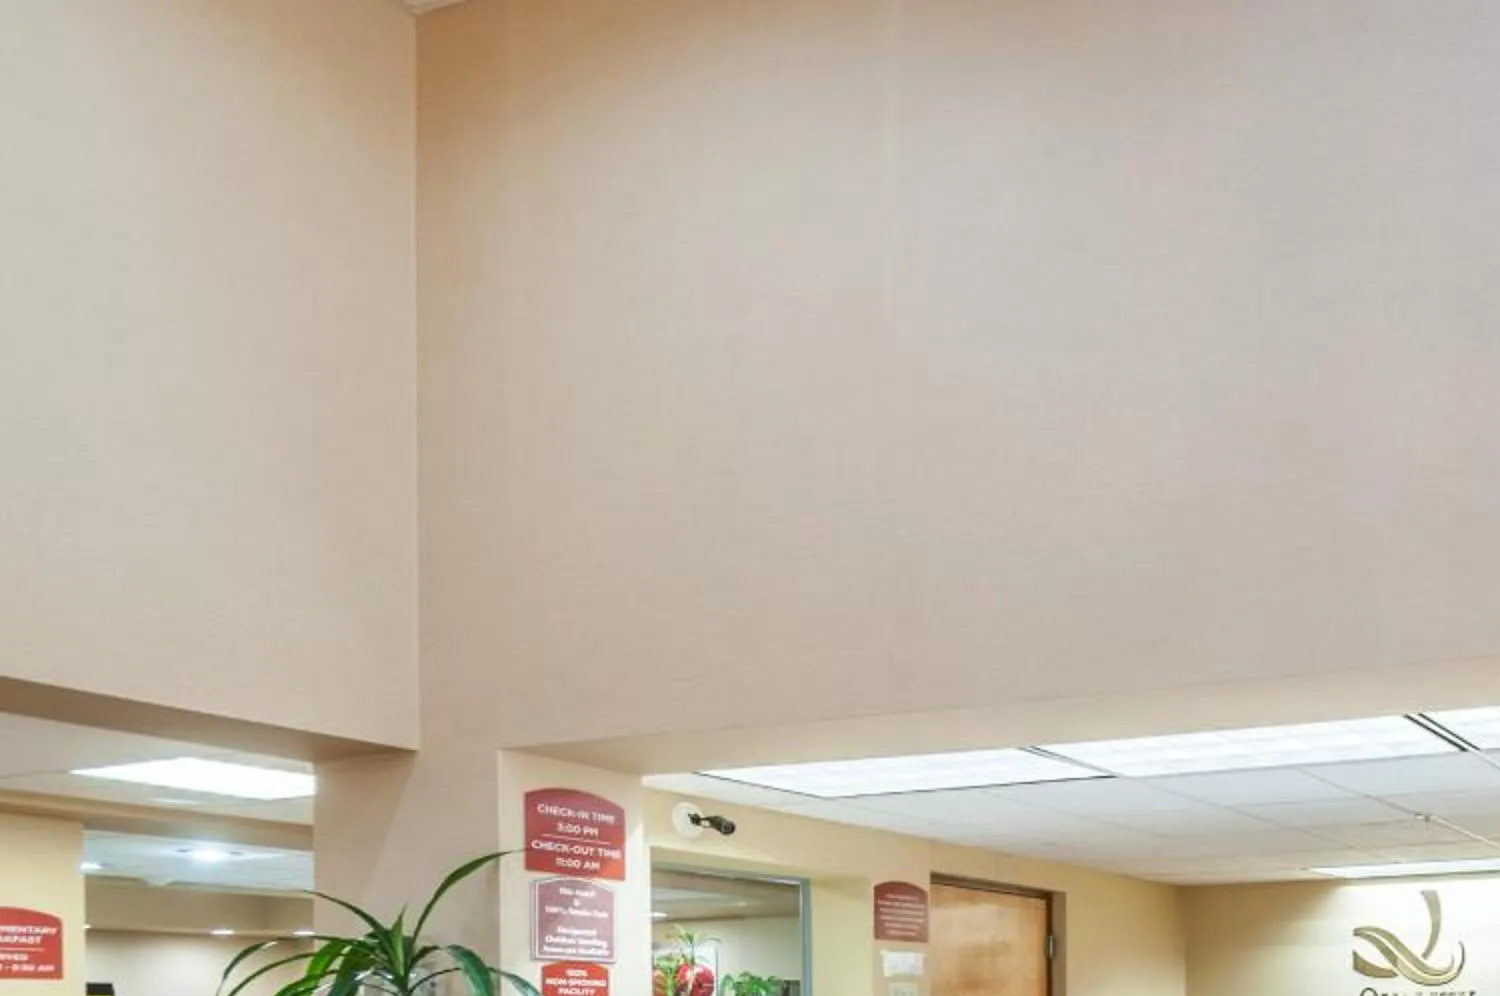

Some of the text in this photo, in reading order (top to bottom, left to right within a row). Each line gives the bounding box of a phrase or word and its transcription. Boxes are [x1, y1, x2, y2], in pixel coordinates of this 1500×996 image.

[537, 803, 615, 824] CHECK-IN TIME
[531, 839, 621, 859] CHECK-OUT TIME
[582, 861, 600, 870] AM
